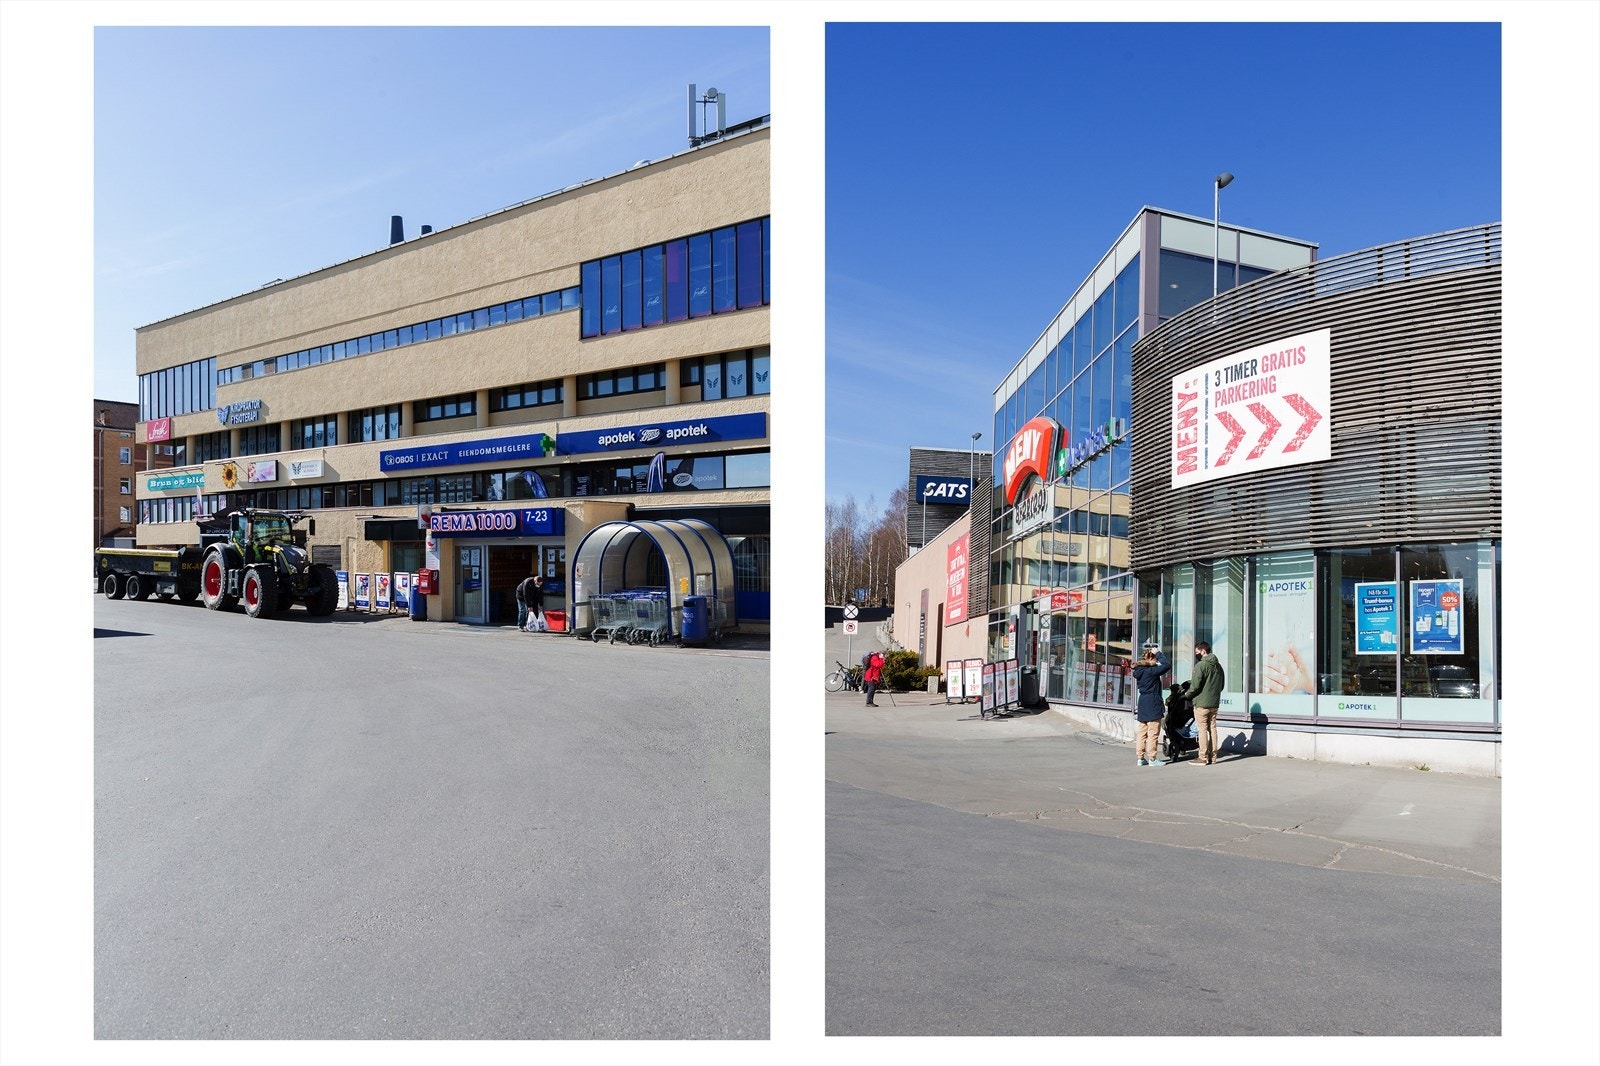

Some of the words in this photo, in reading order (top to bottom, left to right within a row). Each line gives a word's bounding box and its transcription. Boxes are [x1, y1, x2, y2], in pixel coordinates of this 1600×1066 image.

[1214, 370, 1221, 386] 3
[1224, 359, 1258, 384] TIMER
[1261, 345, 1306, 373] GRATIS
[1214, 375, 1277, 408] PARKERING
[230, 399, 261, 413] KIROPRAKTOR
[230, 411, 259, 425] FYSIOTERAPI
[598, 431, 635, 447] apotek
[639, 428, 661, 442] Boots
[666, 423, 708, 440] apotek
[395, 455, 414, 464] OBOS
[421, 451, 449, 462] EXACT
[459, 443, 531, 458] EIENDOMSMEGLERE
[1005, 429, 1042, 486] MENY
[150, 479, 172, 488] Brun
[174, 478, 185, 487] og
[695, 474, 718, 484] apotek
[923, 482, 969, 498] SATS
[430, 513, 477, 532] REMA
[477, 512, 516, 531] 1000
[526, 511, 548, 522] 7-23
[1268, 581, 1306, 592] APOTEK
[1308, 581, 1313, 590] 1
